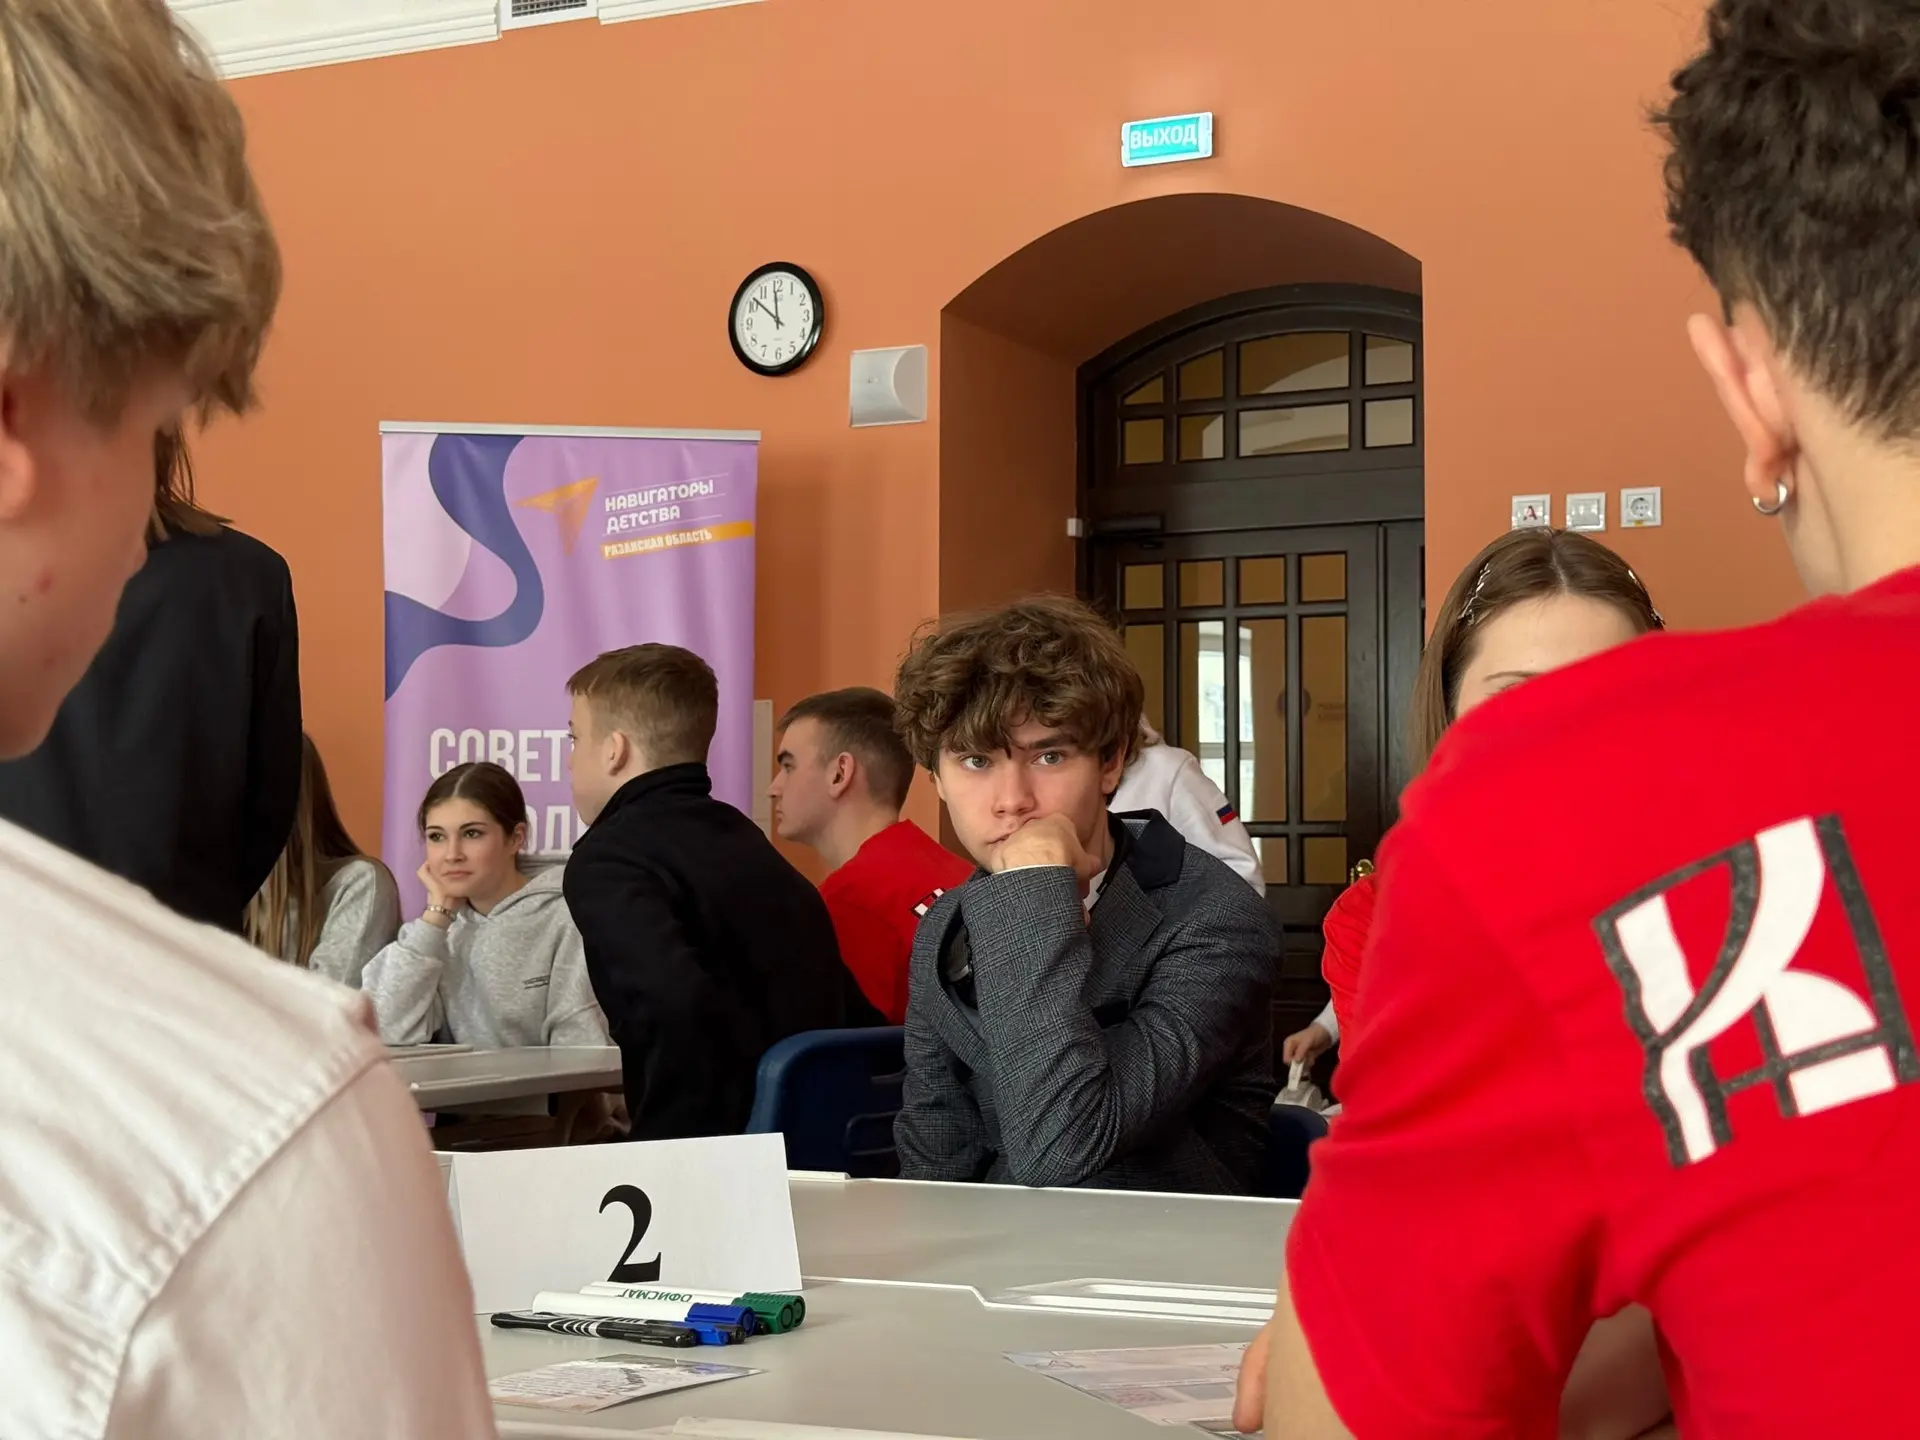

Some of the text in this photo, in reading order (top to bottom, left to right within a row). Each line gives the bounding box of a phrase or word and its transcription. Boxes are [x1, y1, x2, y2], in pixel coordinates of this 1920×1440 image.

[1130, 123, 1197, 149] ВЫХОД
[799, 292, 806, 307] 2
[802, 308, 810, 323] 3
[746, 317, 753, 331] 9
[799, 327, 806, 341] 4
[760, 344, 767, 358] 7
[775, 347, 782, 361] 6
[788, 340, 796, 354] 5
[605, 479, 714, 512] НАВИГАТОРЫ
[606, 505, 681, 535] ДЕТСТВА
[603, 528, 713, 558] РЯЗАНСКАЯ ОБЛАСТЬ
[429, 727, 575, 782] СОВЕТ
[598, 1183, 662, 1284] 2
[614, 1288, 693, 1303] ОФИСМАГ
